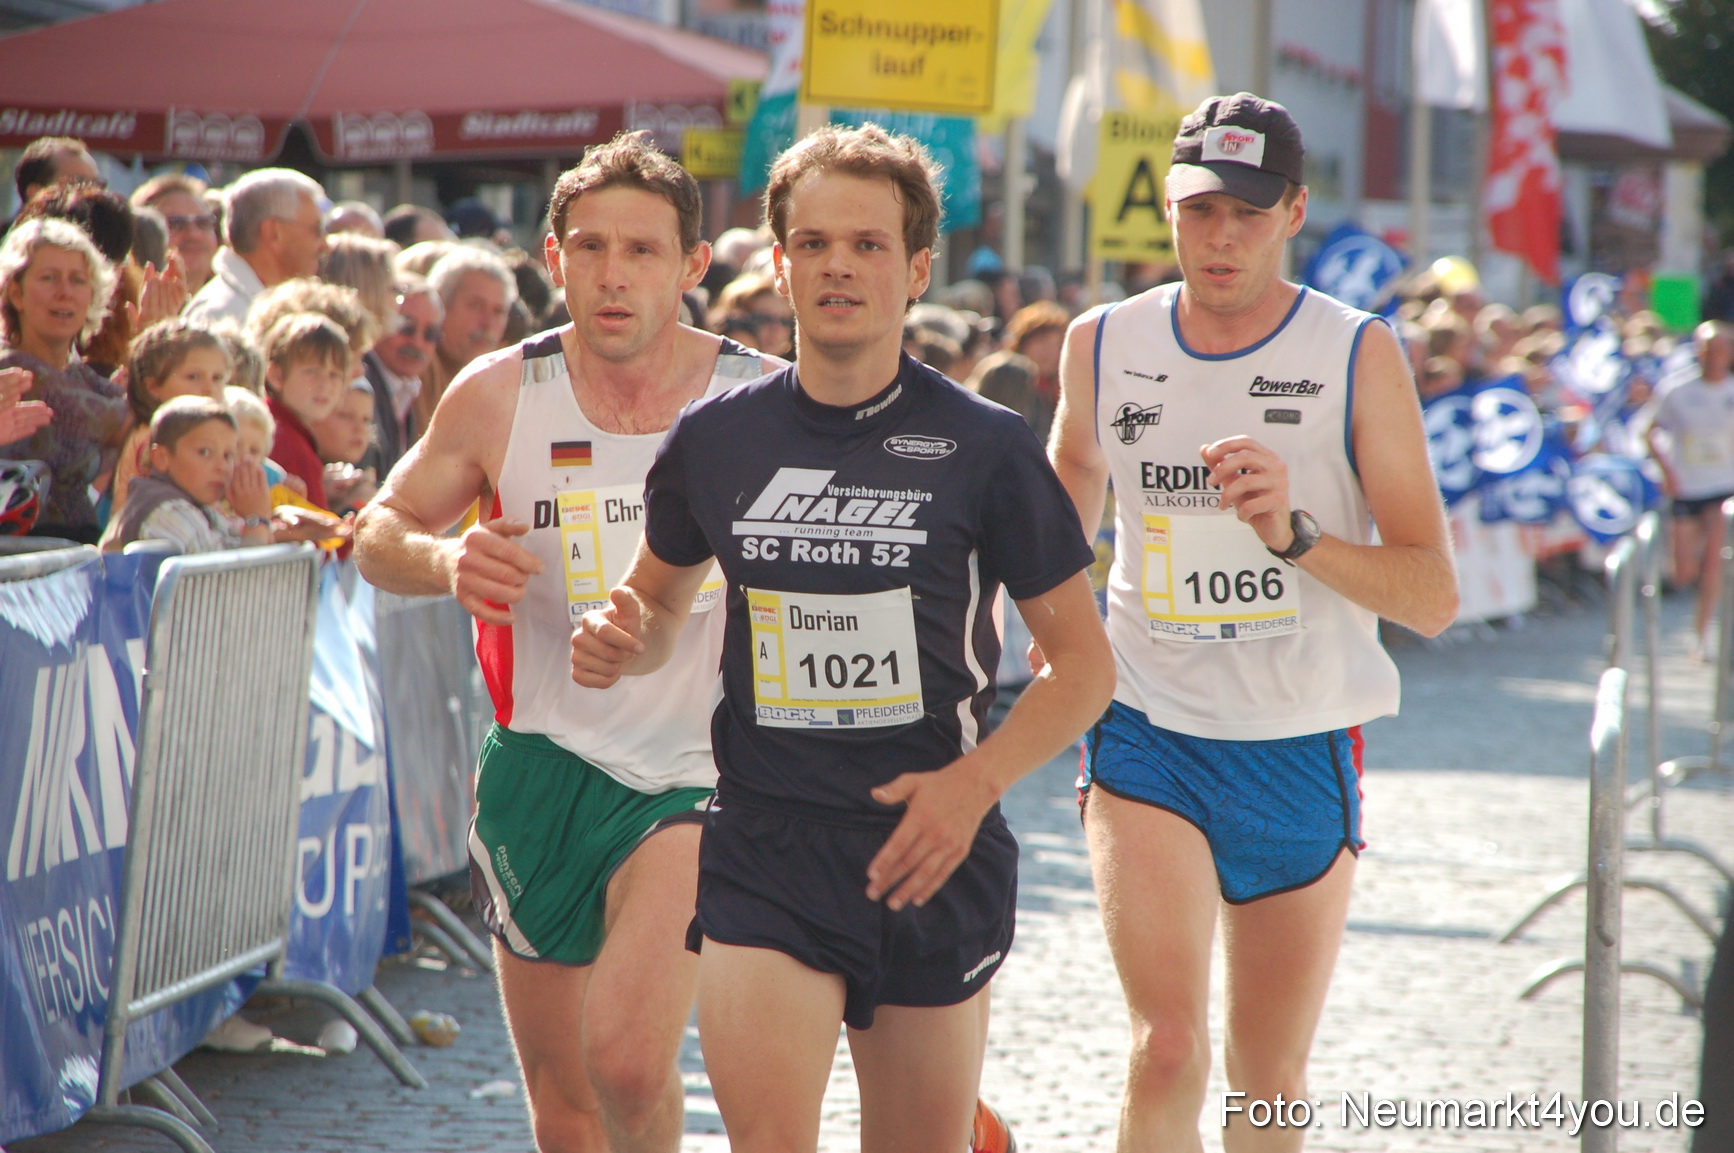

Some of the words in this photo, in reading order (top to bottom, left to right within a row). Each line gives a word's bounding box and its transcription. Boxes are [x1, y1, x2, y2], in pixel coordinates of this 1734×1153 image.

[819, 12, 985, 44] Schnupper-
[873, 53, 924, 76] lauf
[1116, 156, 1164, 223] A
[1249, 375, 1325, 397] PowerBar
[890, 438, 936, 449] SYNERGY
[906, 446, 948, 455] SPORTS
[1140, 461, 1221, 493] ERDIN
[827, 484, 933, 502] Versicherungsbüro
[1144, 495, 1236, 508] ALKOHO
[605, 499, 643, 524] Chr
[773, 495, 921, 528] NAGEL
[794, 525, 840, 538] running
[845, 528, 874, 537] team
[571, 543, 581, 560] A
[741, 537, 781, 561] SC
[790, 539, 860, 564] Roth
[871, 543, 911, 568] 52
[1185, 567, 1285, 604] 1066
[789, 605, 858, 632] Dorian
[1151, 619, 1200, 636] BOCK
[1238, 615, 1298, 632] PFLEIDERER
[760, 641, 768, 660] A
[799, 650, 900, 689] 1021
[758, 705, 816, 721] BOCK
[856, 702, 920, 719] PFLEIDERER
